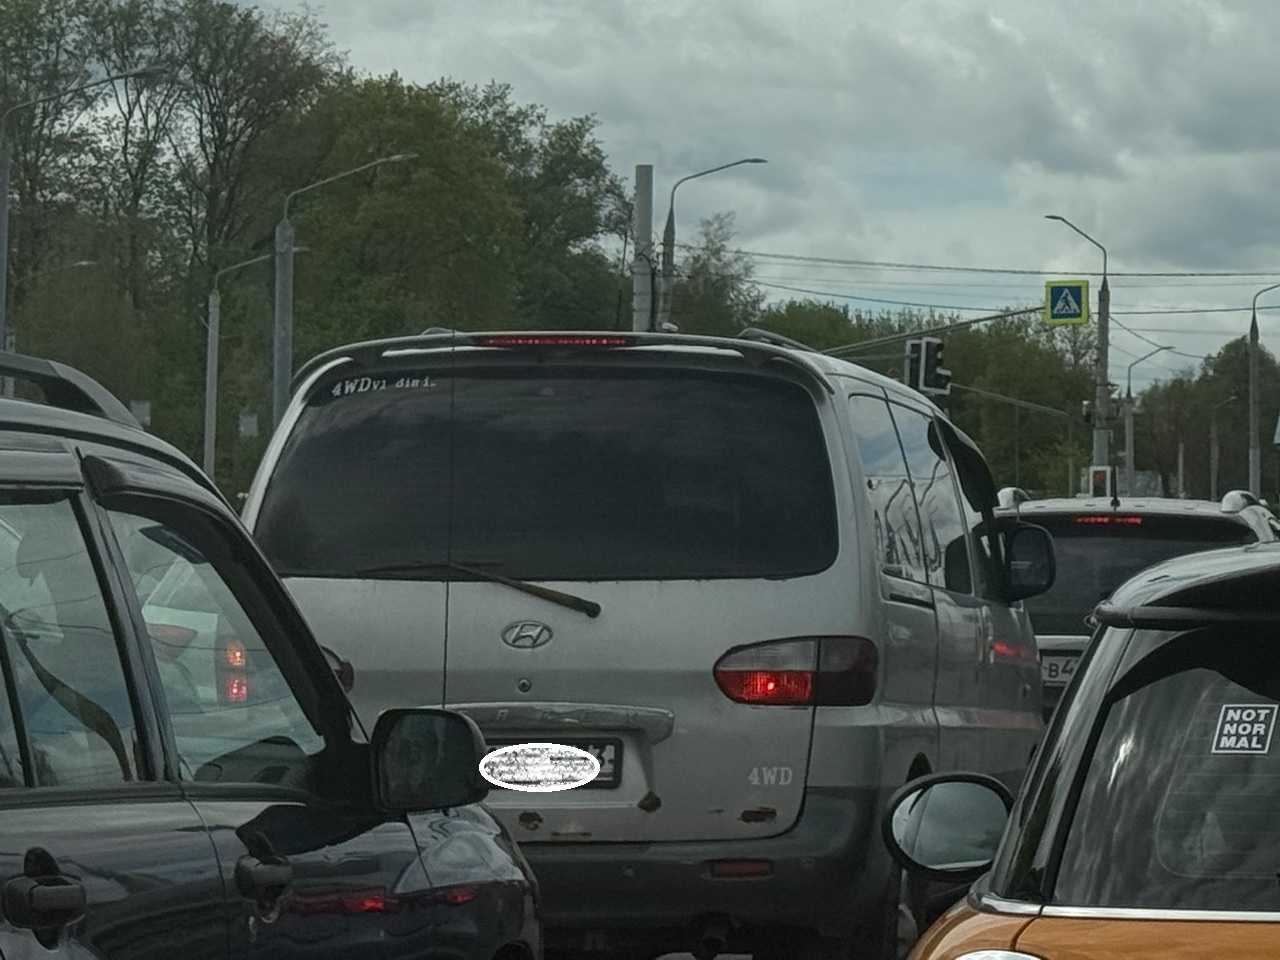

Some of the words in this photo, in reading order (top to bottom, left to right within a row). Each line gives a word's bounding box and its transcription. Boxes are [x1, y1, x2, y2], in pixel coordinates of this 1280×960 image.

[1225, 708, 1271, 722] NOT
[1222, 722, 1266, 736] NOR
[1219, 736, 1263, 749] MAL
[748, 766, 793, 785] 4WD
